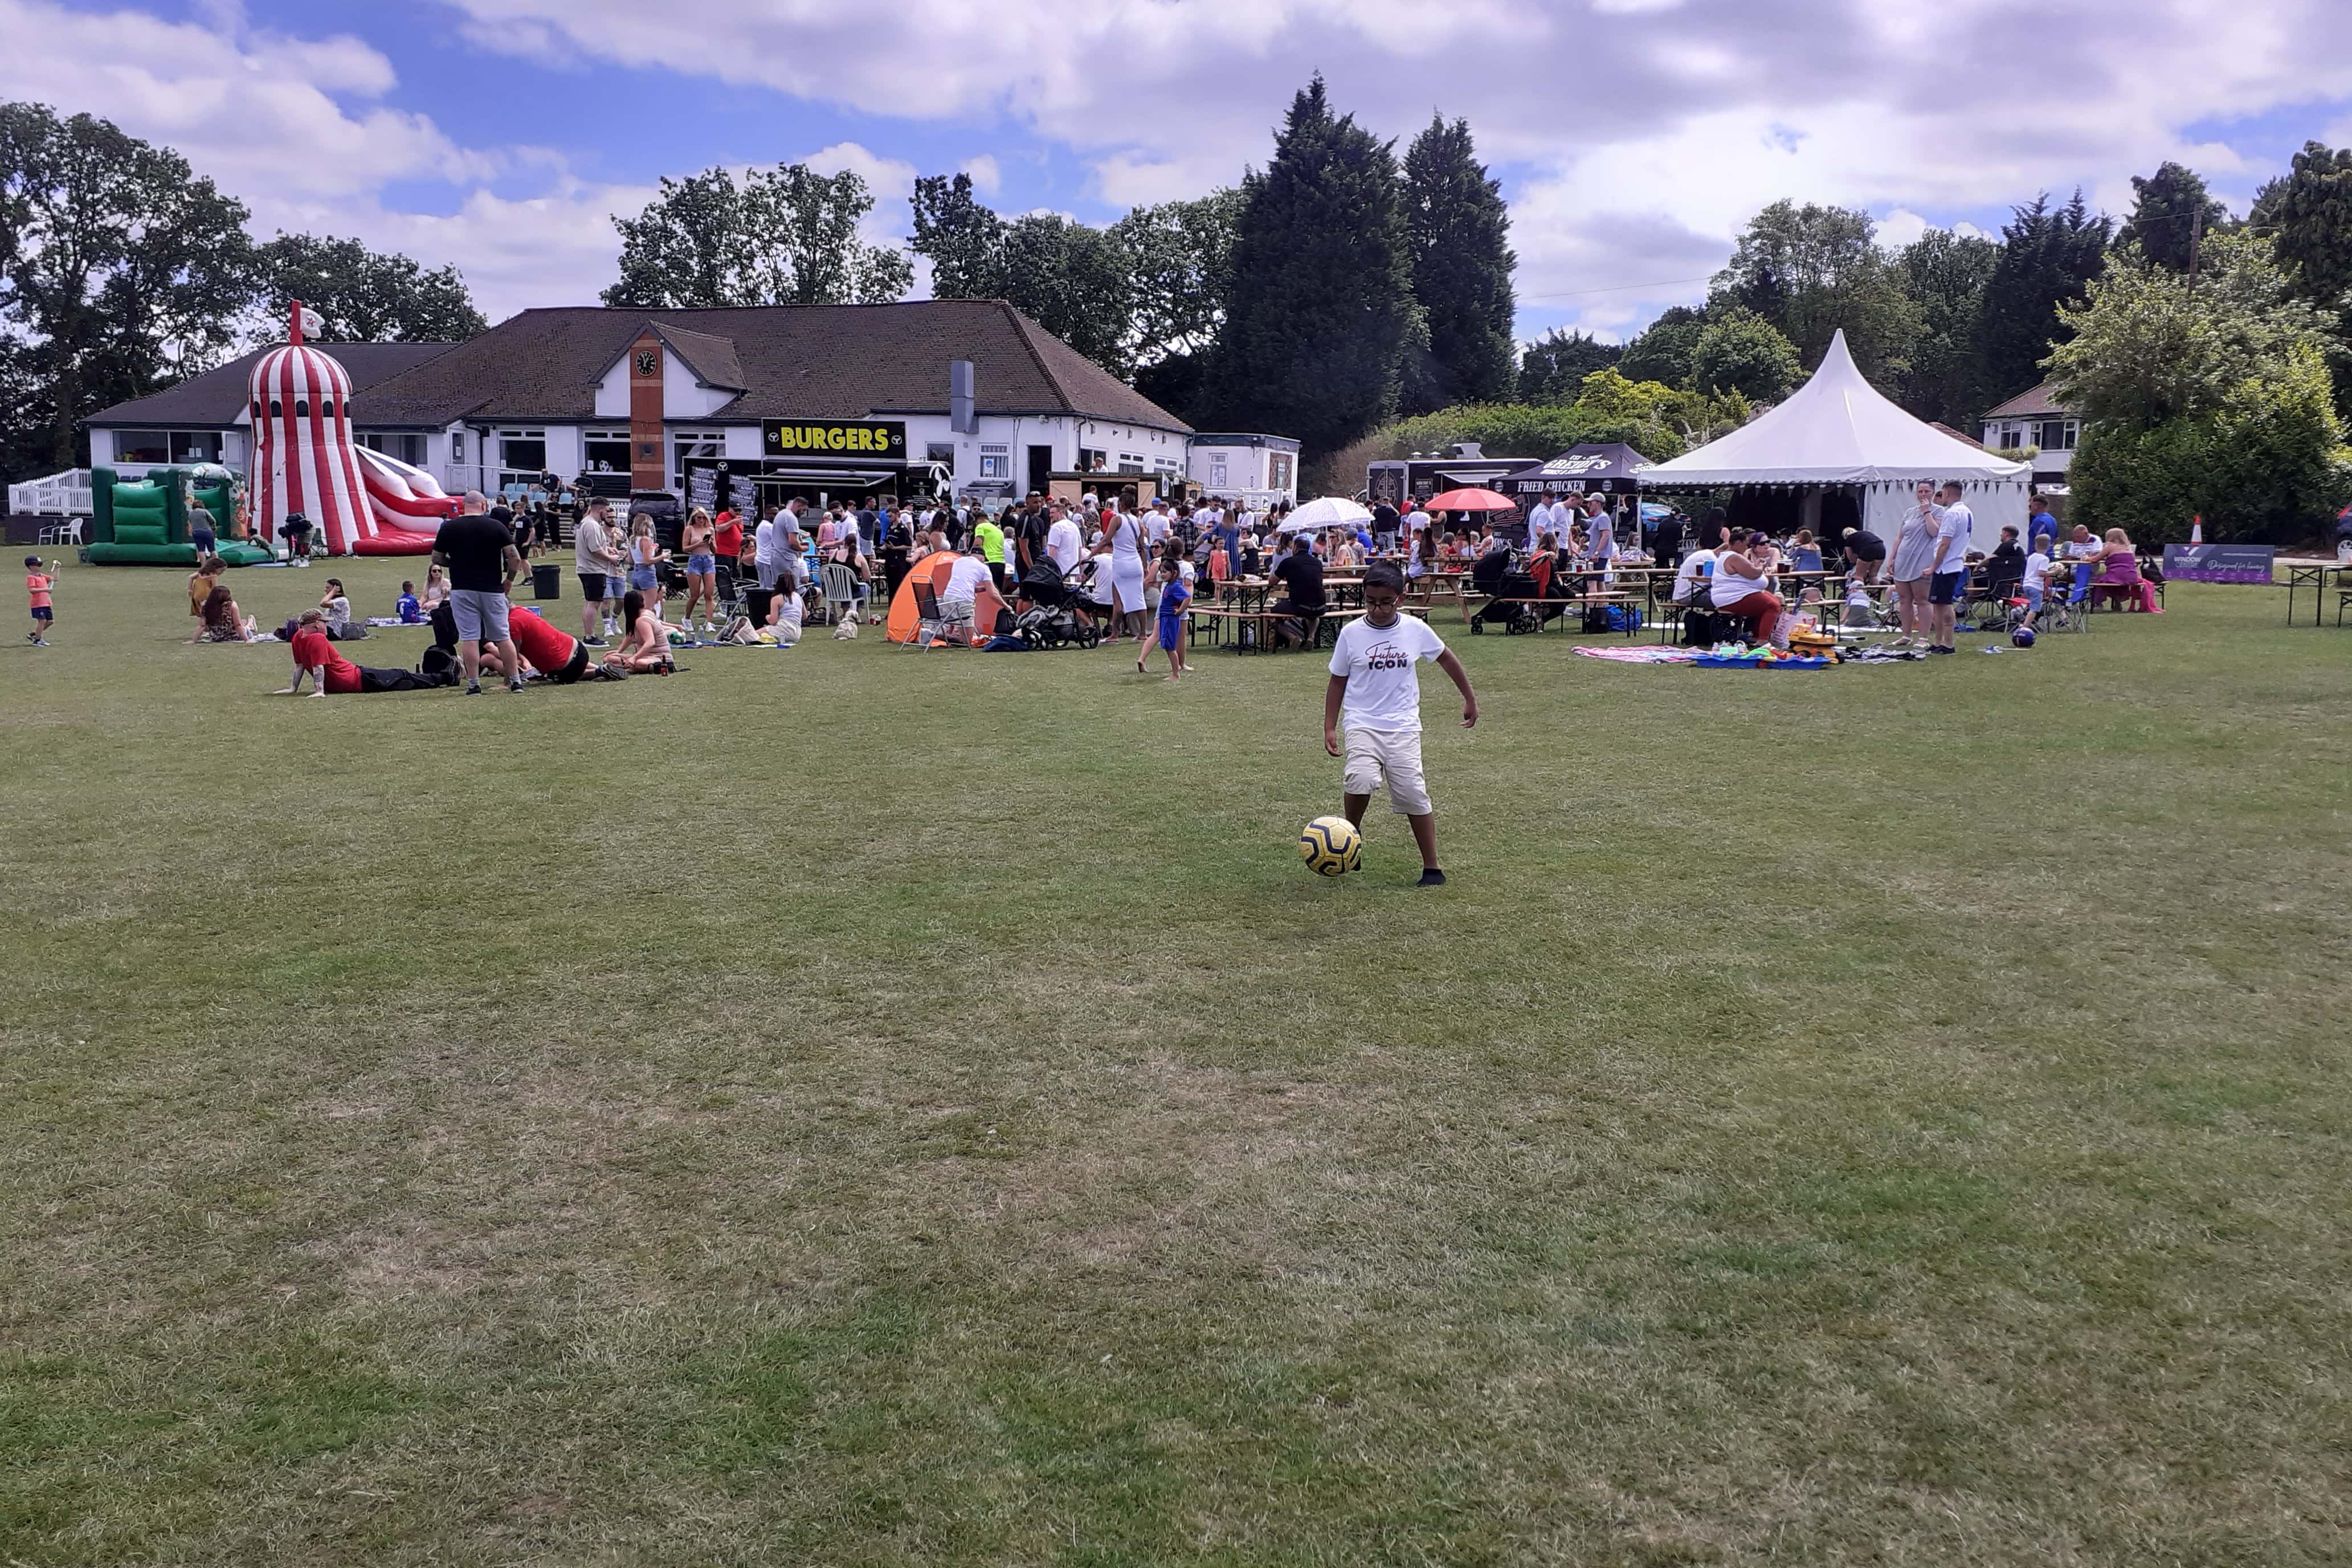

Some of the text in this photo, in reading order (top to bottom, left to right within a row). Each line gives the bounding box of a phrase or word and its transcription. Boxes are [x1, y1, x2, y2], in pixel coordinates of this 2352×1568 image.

[781, 427, 889, 451] BURGERS
[1517, 480, 1586, 492] FRIED CHICKEN
[1365, 640, 1408, 672] Future
[1369, 659, 1407, 671] ICON
